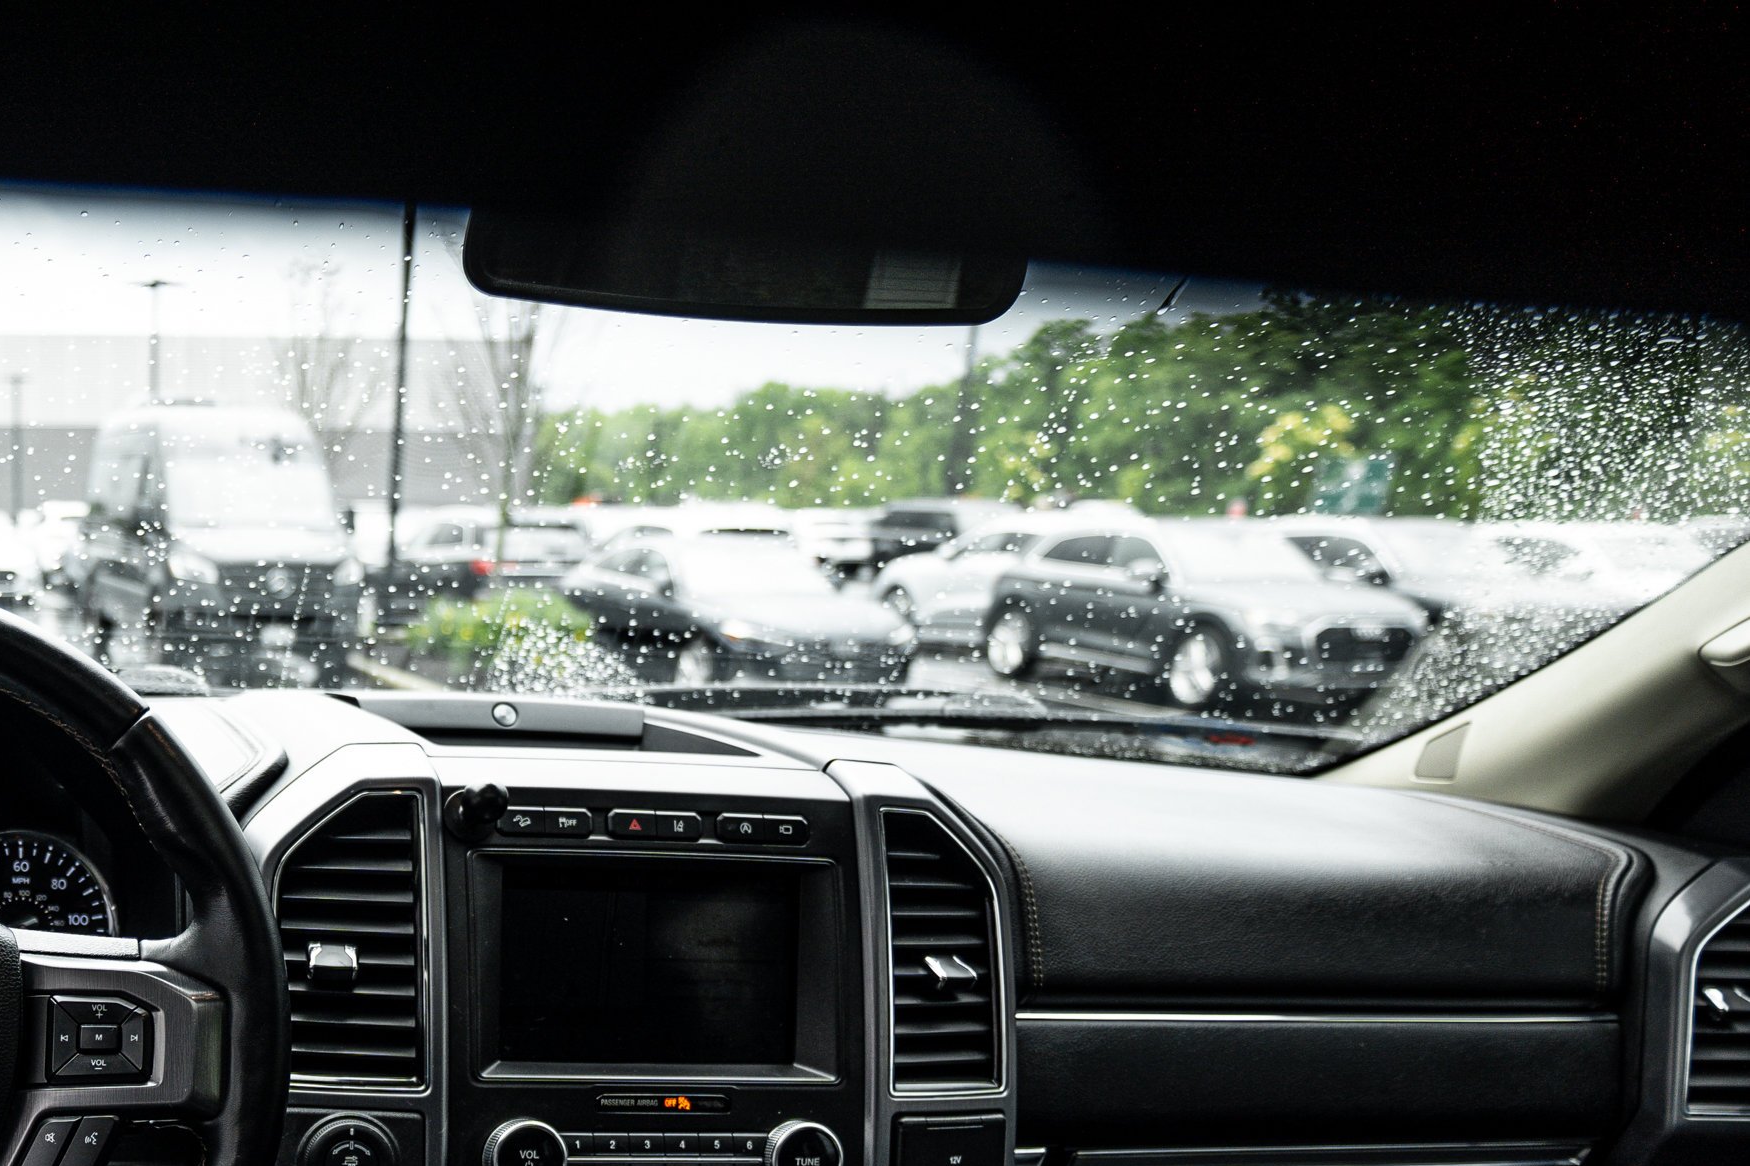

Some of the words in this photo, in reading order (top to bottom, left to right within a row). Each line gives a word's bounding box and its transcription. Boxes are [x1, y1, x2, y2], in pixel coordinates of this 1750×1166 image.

[566, 818, 578, 827] OFF
[12, 860, 31, 873] 60
[11, 876, 31, 885] MPH
[50, 878, 68, 891] 80
[18, 889, 31, 897] 100
[67, 913, 89, 926] 100
[91, 1003, 108, 1012] VOL
[95, 1033, 103, 1041] M
[90, 1059, 107, 1067] VOL
[600, 1098, 635, 1107] PASSENGER
[636, 1098, 659, 1107] AIRBAG
[663, 1097, 677, 1108] OFF
[574, 1139, 581, 1150] 1
[609, 1139, 617, 1150] 2
[643, 1139, 651, 1150] 3
[678, 1139, 686, 1150] 4
[713, 1139, 721, 1150] 5
[746, 1140, 754, 1150] 6
[519, 1150, 540, 1160] VOL
[949, 1155, 963, 1165] 12V
[794, 1157, 821, 1166] TUNE
